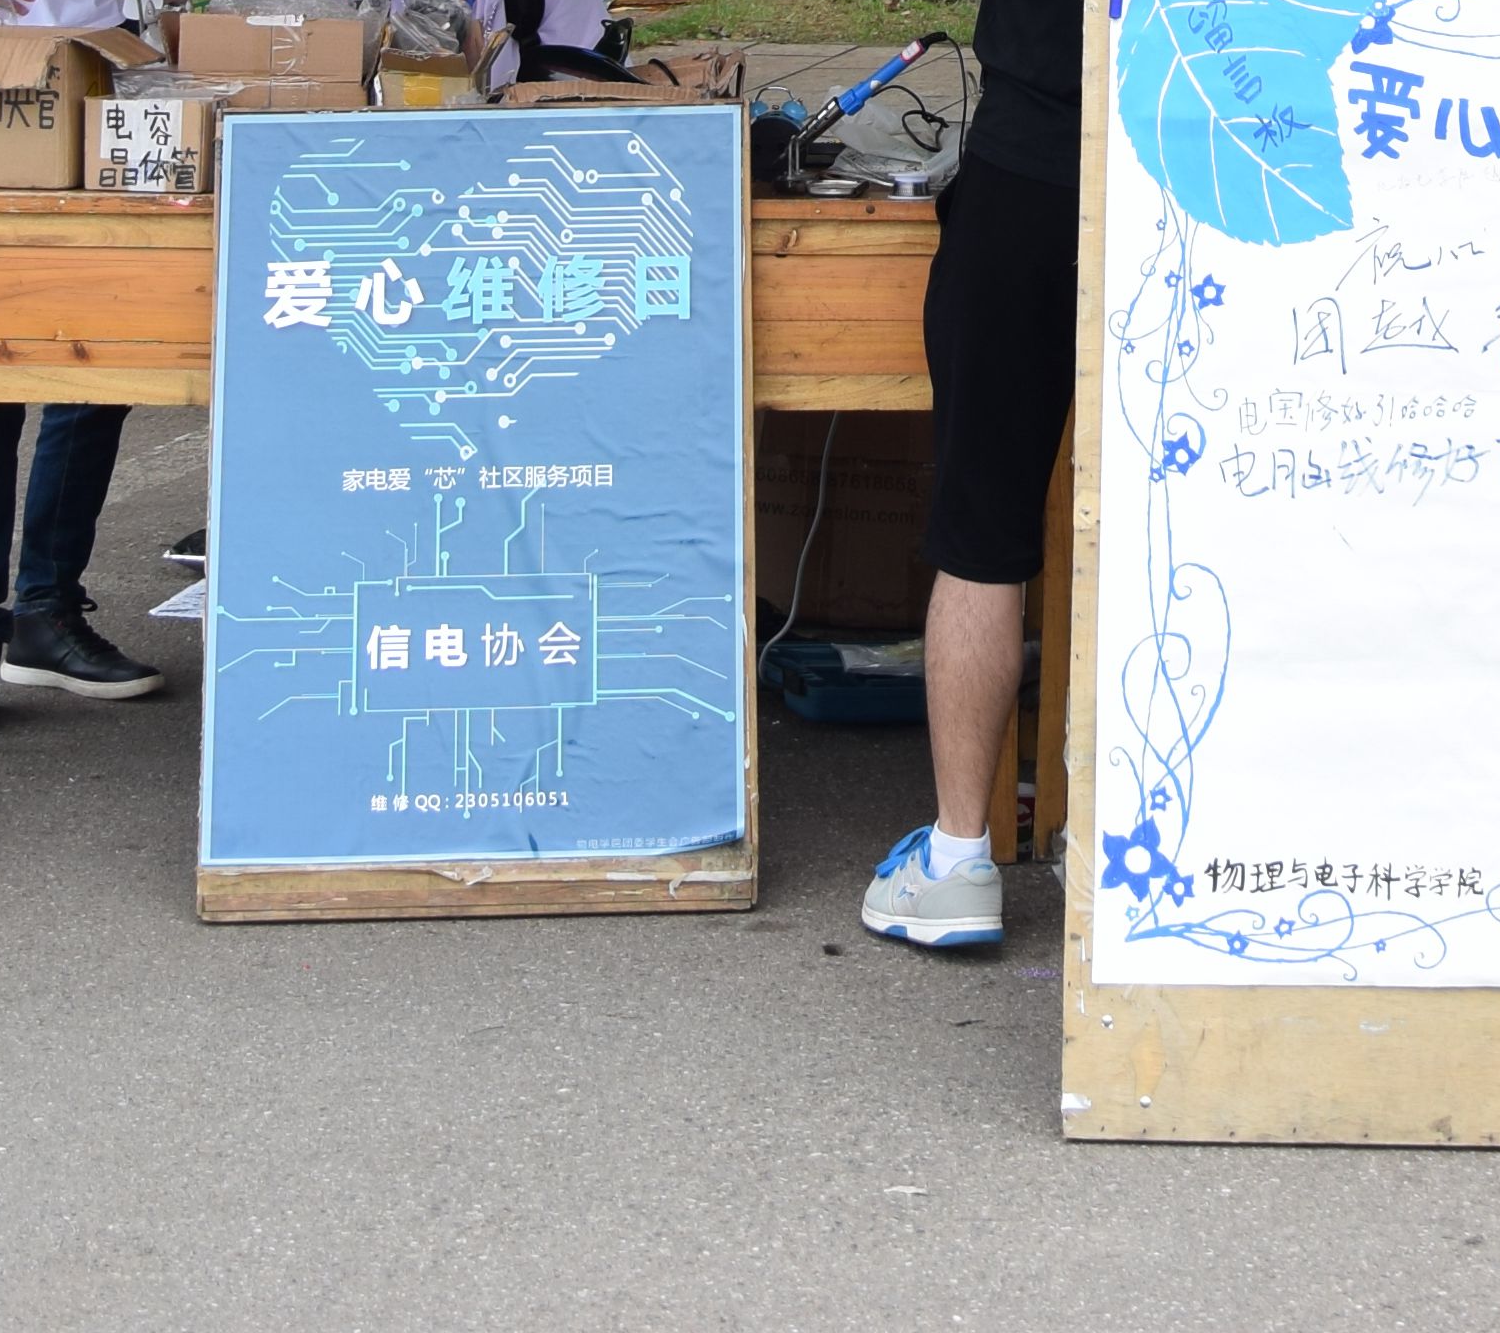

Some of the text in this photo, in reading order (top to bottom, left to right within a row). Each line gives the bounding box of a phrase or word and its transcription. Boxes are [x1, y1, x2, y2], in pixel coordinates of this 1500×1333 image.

[106, 103, 172, 146] 电容
[99, 147, 198, 190] 晶体管
[263, 255, 691, 328] 爱心维修日
[366, 621, 581, 670] 信电协会
[1203, 856, 1485, 901] 物理与电子科学学院
